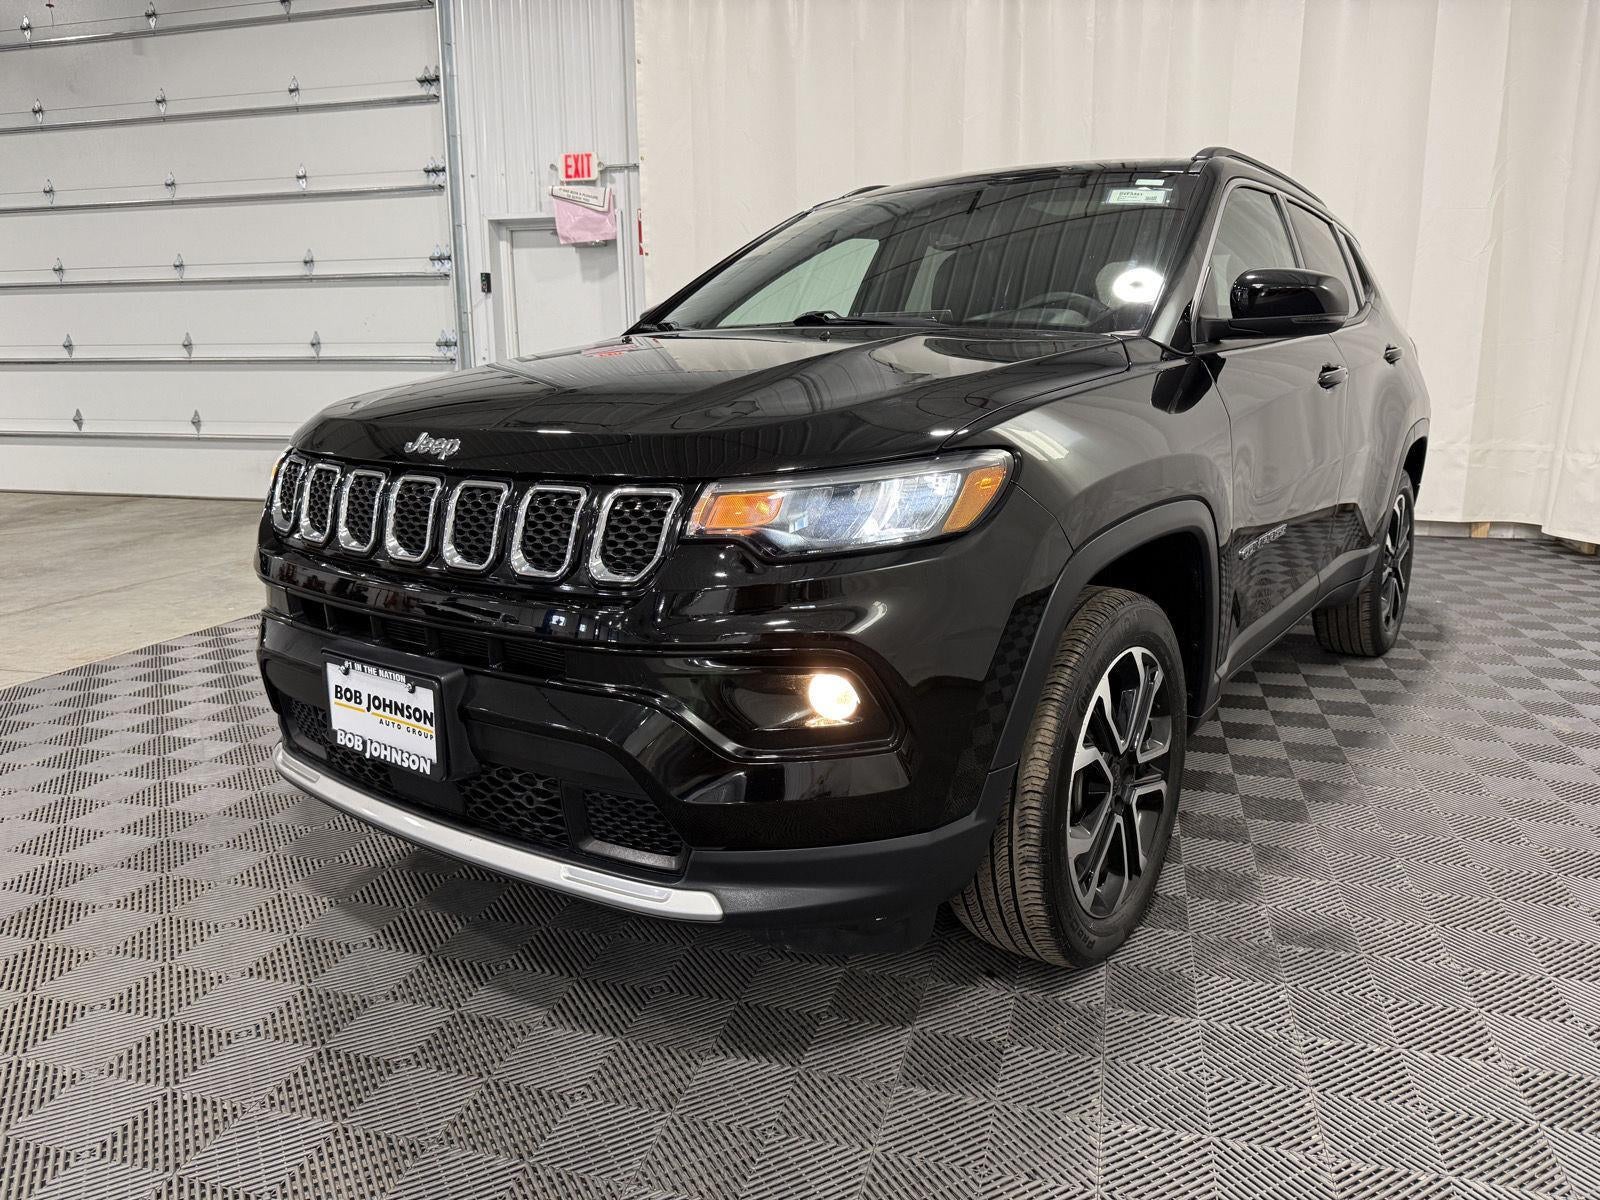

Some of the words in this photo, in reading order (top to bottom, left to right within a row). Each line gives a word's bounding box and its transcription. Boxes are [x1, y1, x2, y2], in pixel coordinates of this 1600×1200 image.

[564, 153, 592, 179] EXIT
[404, 431, 461, 461] Jeep
[344, 660, 352, 670] #1
[354, 662, 362, 671] IN
[363, 665, 378, 676] THE
[378, 669, 406, 683] NATION
[334, 684, 363, 705] BOB
[365, 693, 434, 727] JOHNSON
[379, 718, 402, 730] AUTO
[406, 726, 434, 741] GROUP
[336, 729, 363, 751] BOB
[365, 739, 431, 775] JOHNSON
